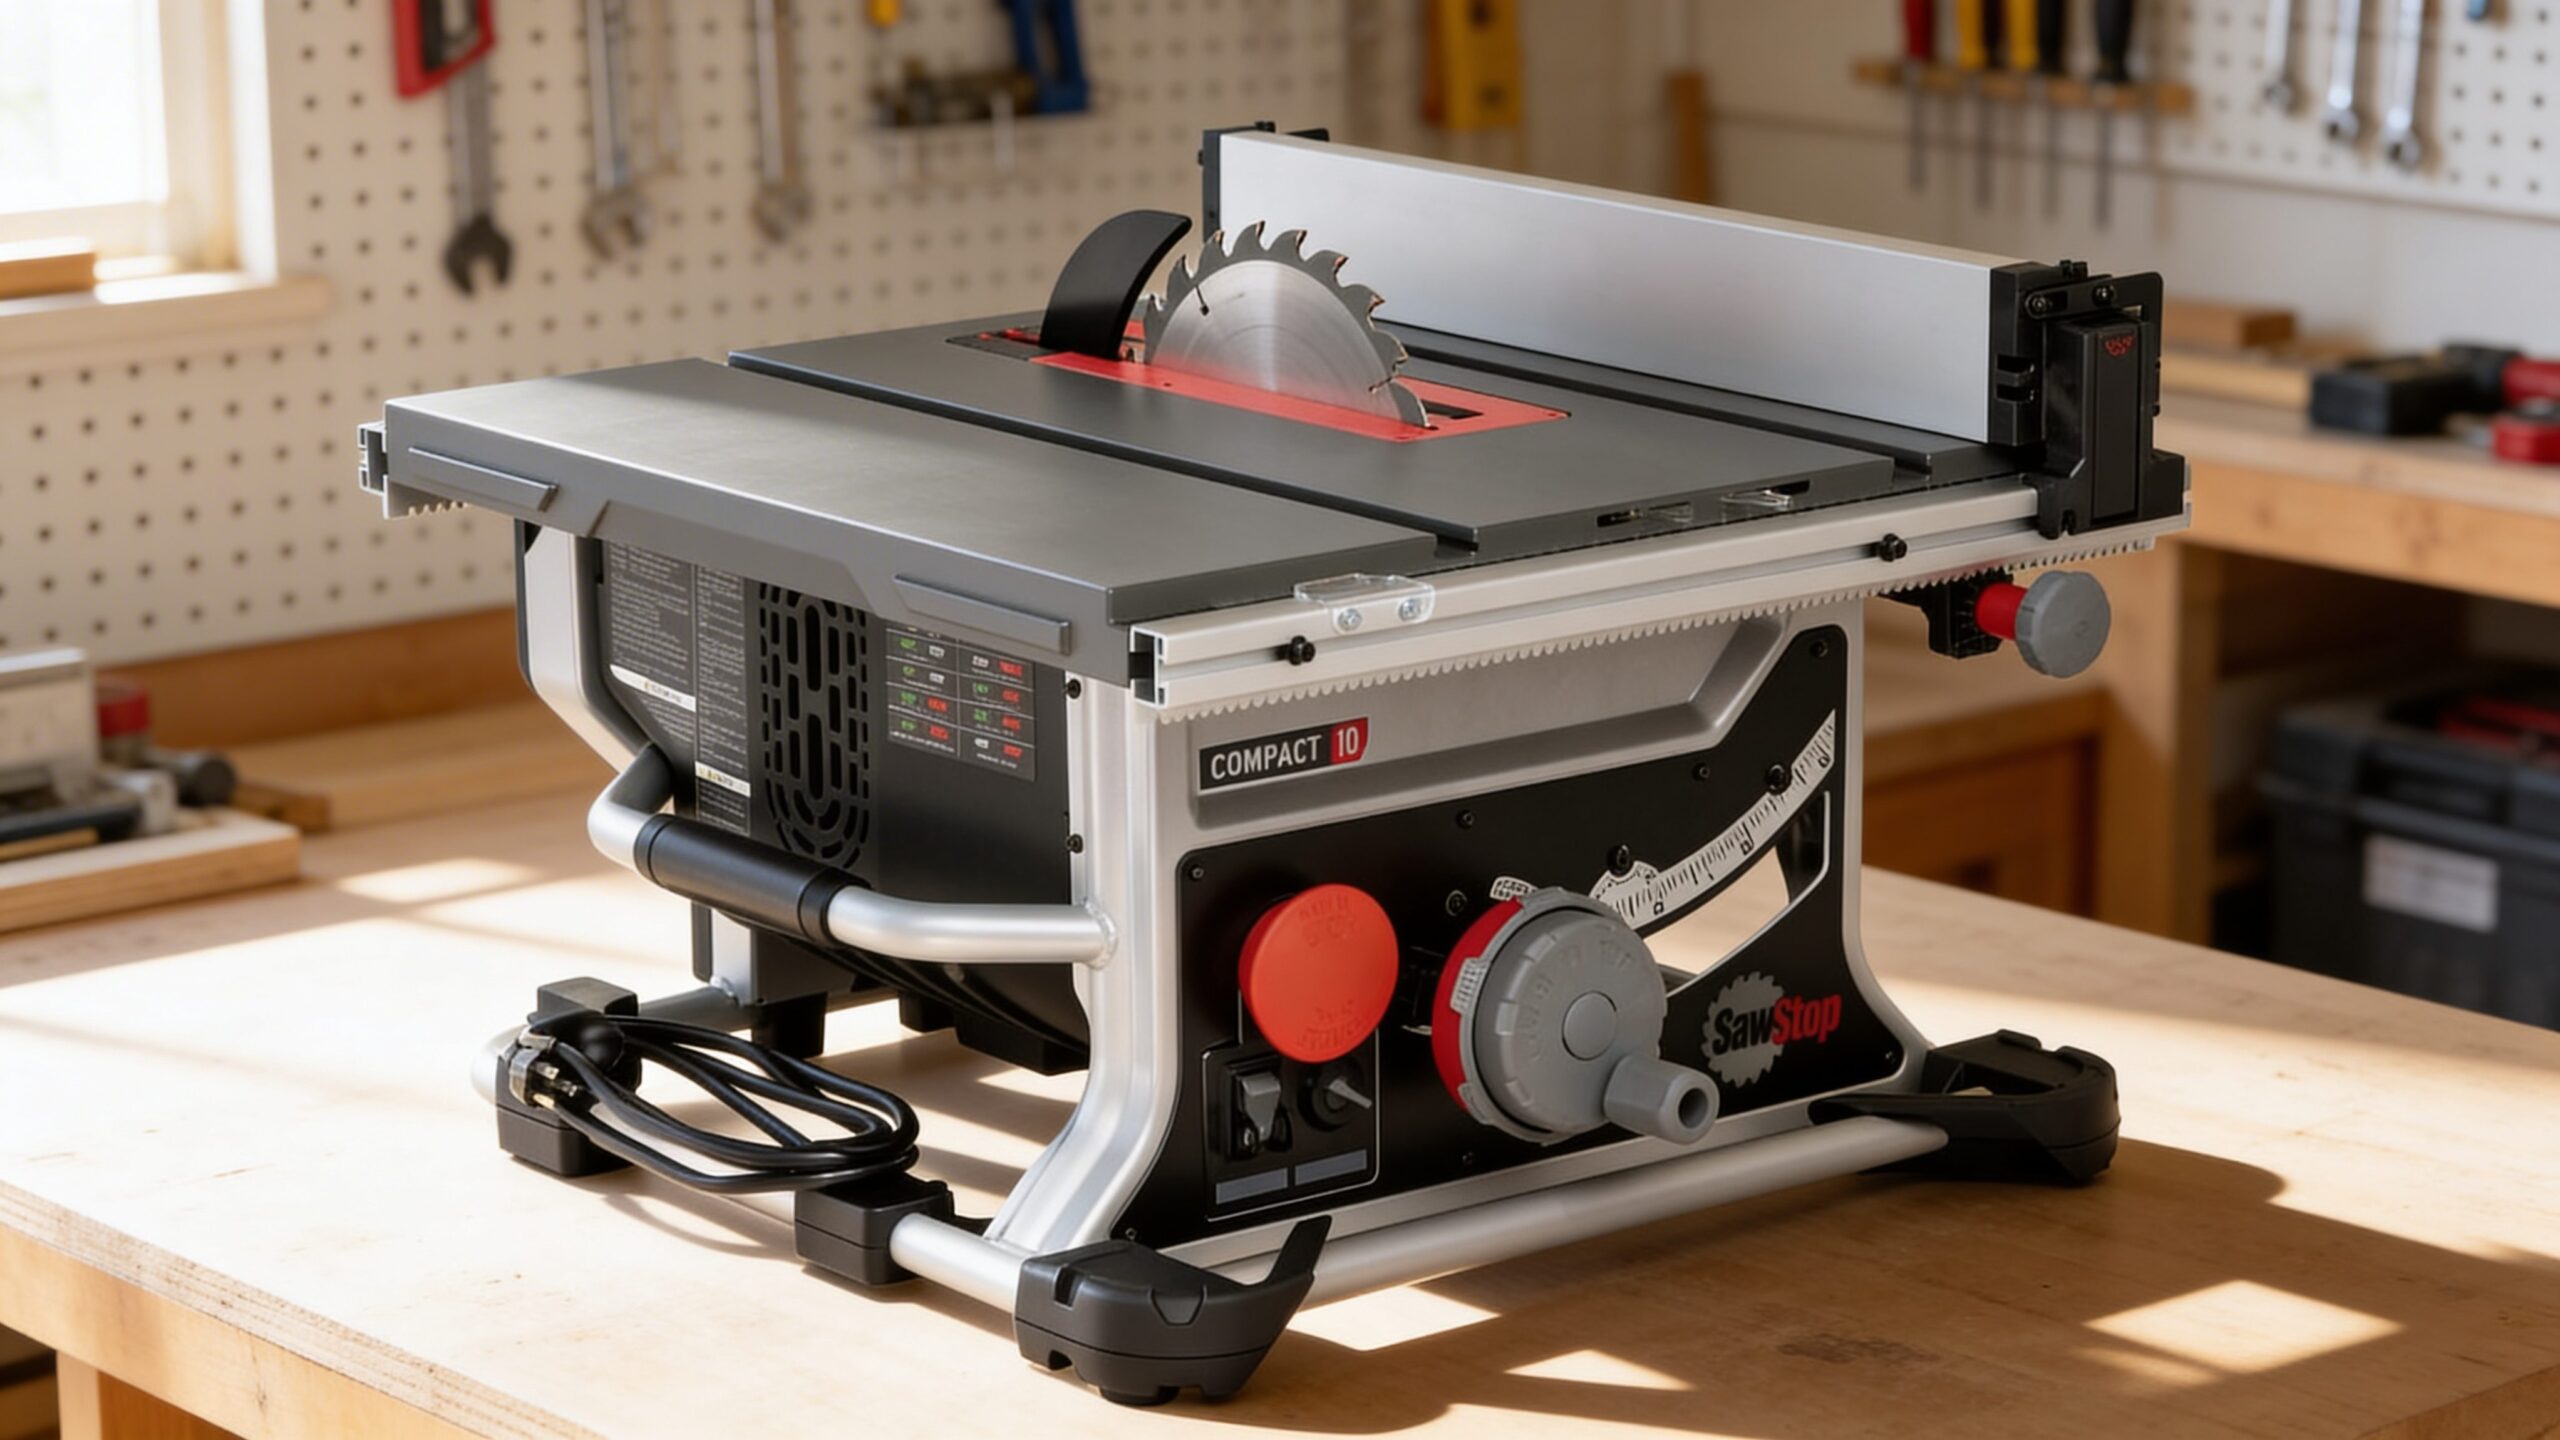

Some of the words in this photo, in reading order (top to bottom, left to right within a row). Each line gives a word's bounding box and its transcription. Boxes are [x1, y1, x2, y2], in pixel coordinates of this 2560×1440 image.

[1211, 735, 1322, 780] COMPACT
[1337, 726, 1360, 758] 10
[1712, 994, 1842, 1056] SawStop
